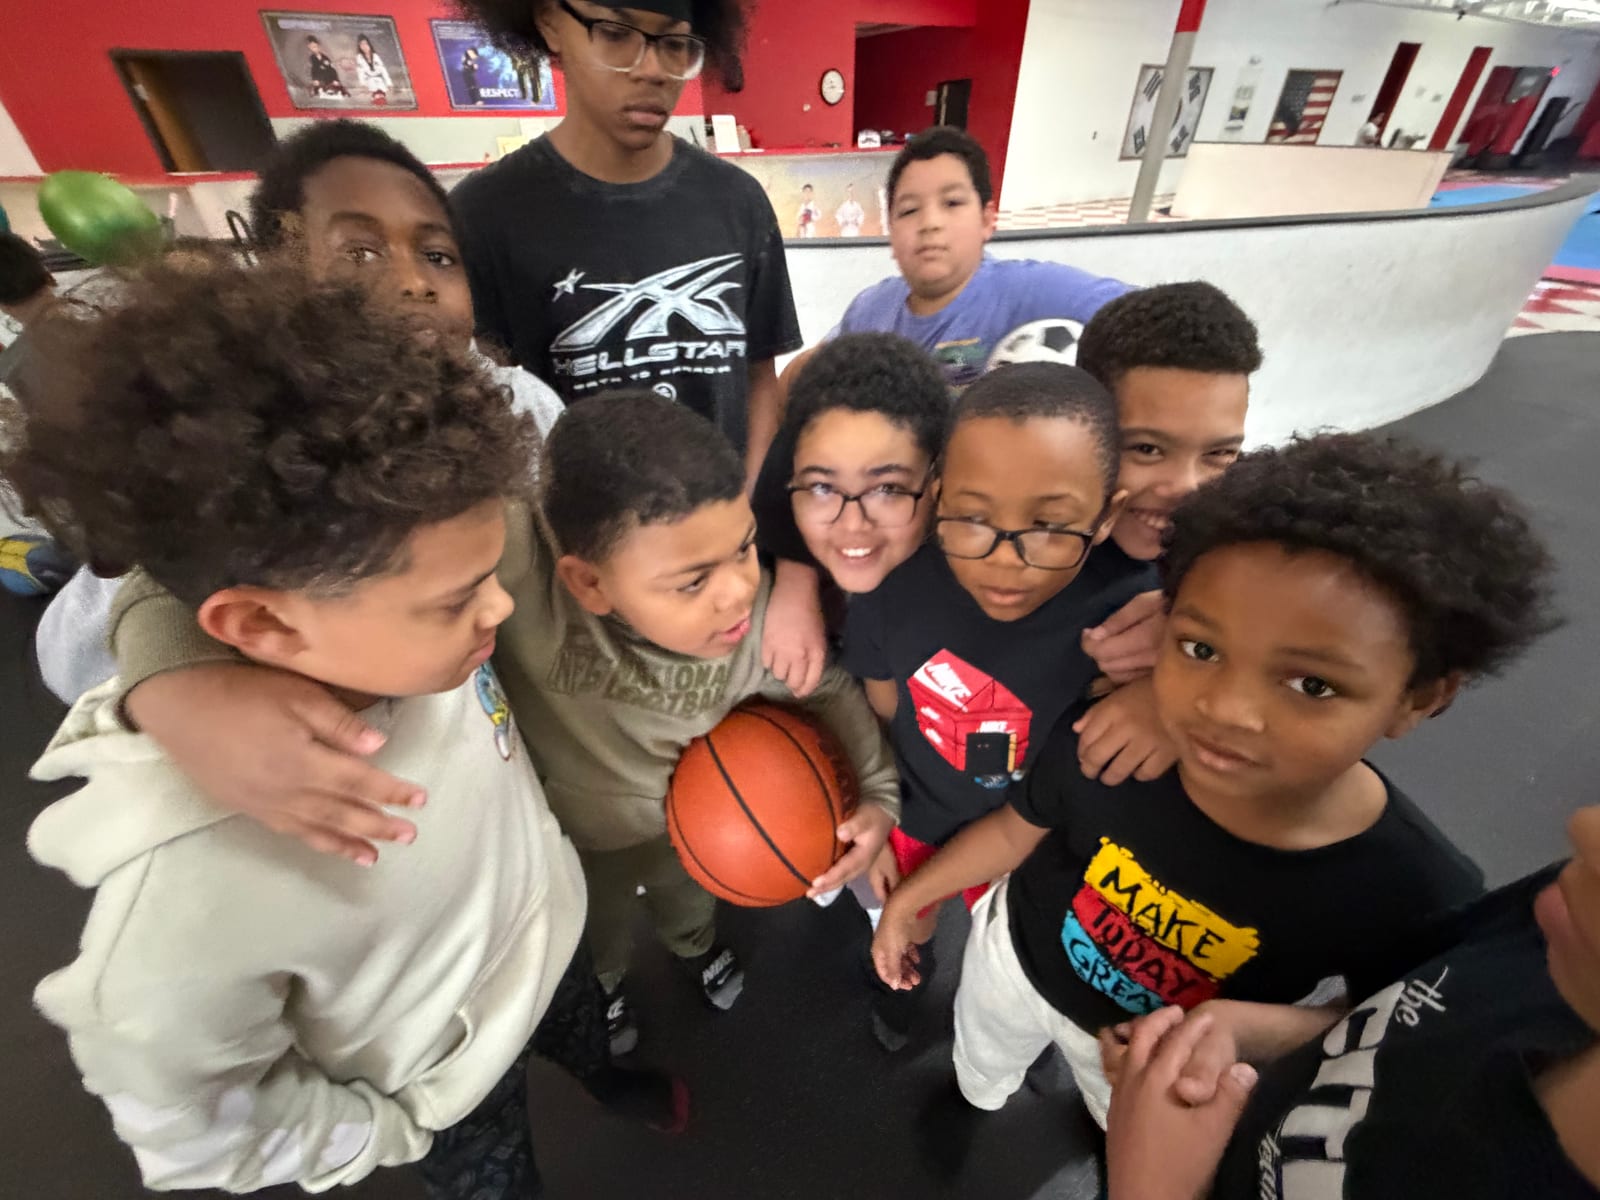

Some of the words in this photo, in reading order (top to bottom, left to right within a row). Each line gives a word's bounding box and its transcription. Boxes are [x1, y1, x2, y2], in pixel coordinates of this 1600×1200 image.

[479, 87, 521, 98] RESPECT
[553, 340, 747, 376] HELLSTAR
[924, 662, 973, 702] NIKE
[1100, 866, 1226, 959] MAKE
[1069, 938, 1152, 1012] GREA
[1093, 897, 1199, 997] TODAY
[1395, 966, 1449, 1027] the
